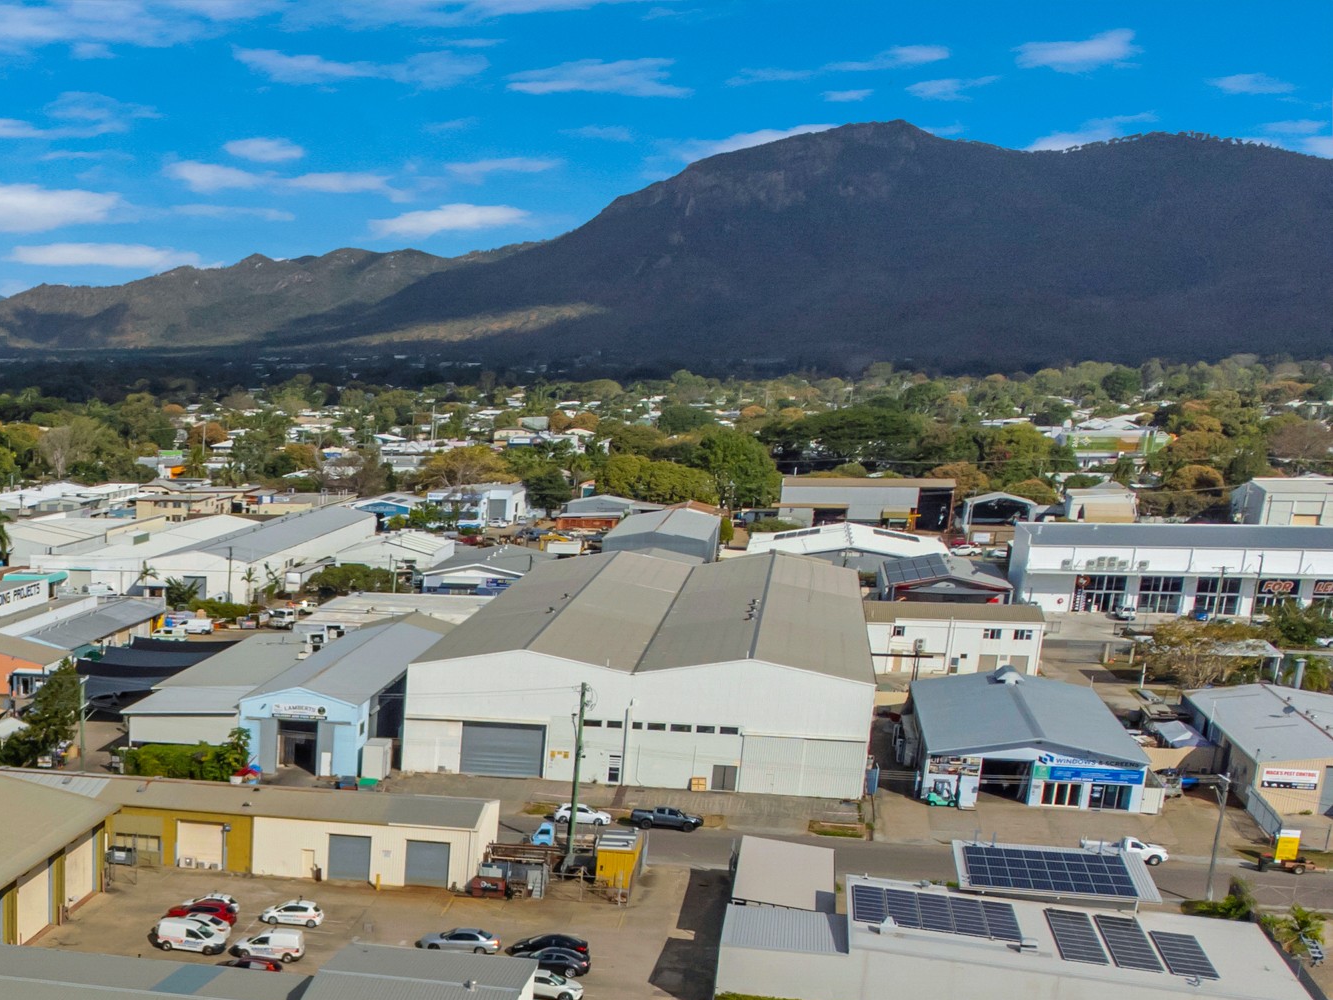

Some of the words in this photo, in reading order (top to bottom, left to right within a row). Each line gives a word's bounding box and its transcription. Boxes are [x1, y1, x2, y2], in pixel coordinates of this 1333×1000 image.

[13, 583, 40, 601] PROJECTS
[1262, 581, 1294, 592] FOR
[1314, 582, 1333, 593] LE
[1056, 758, 1096, 766] WINDOWS
[1106, 760, 1139, 768] SCREENS
